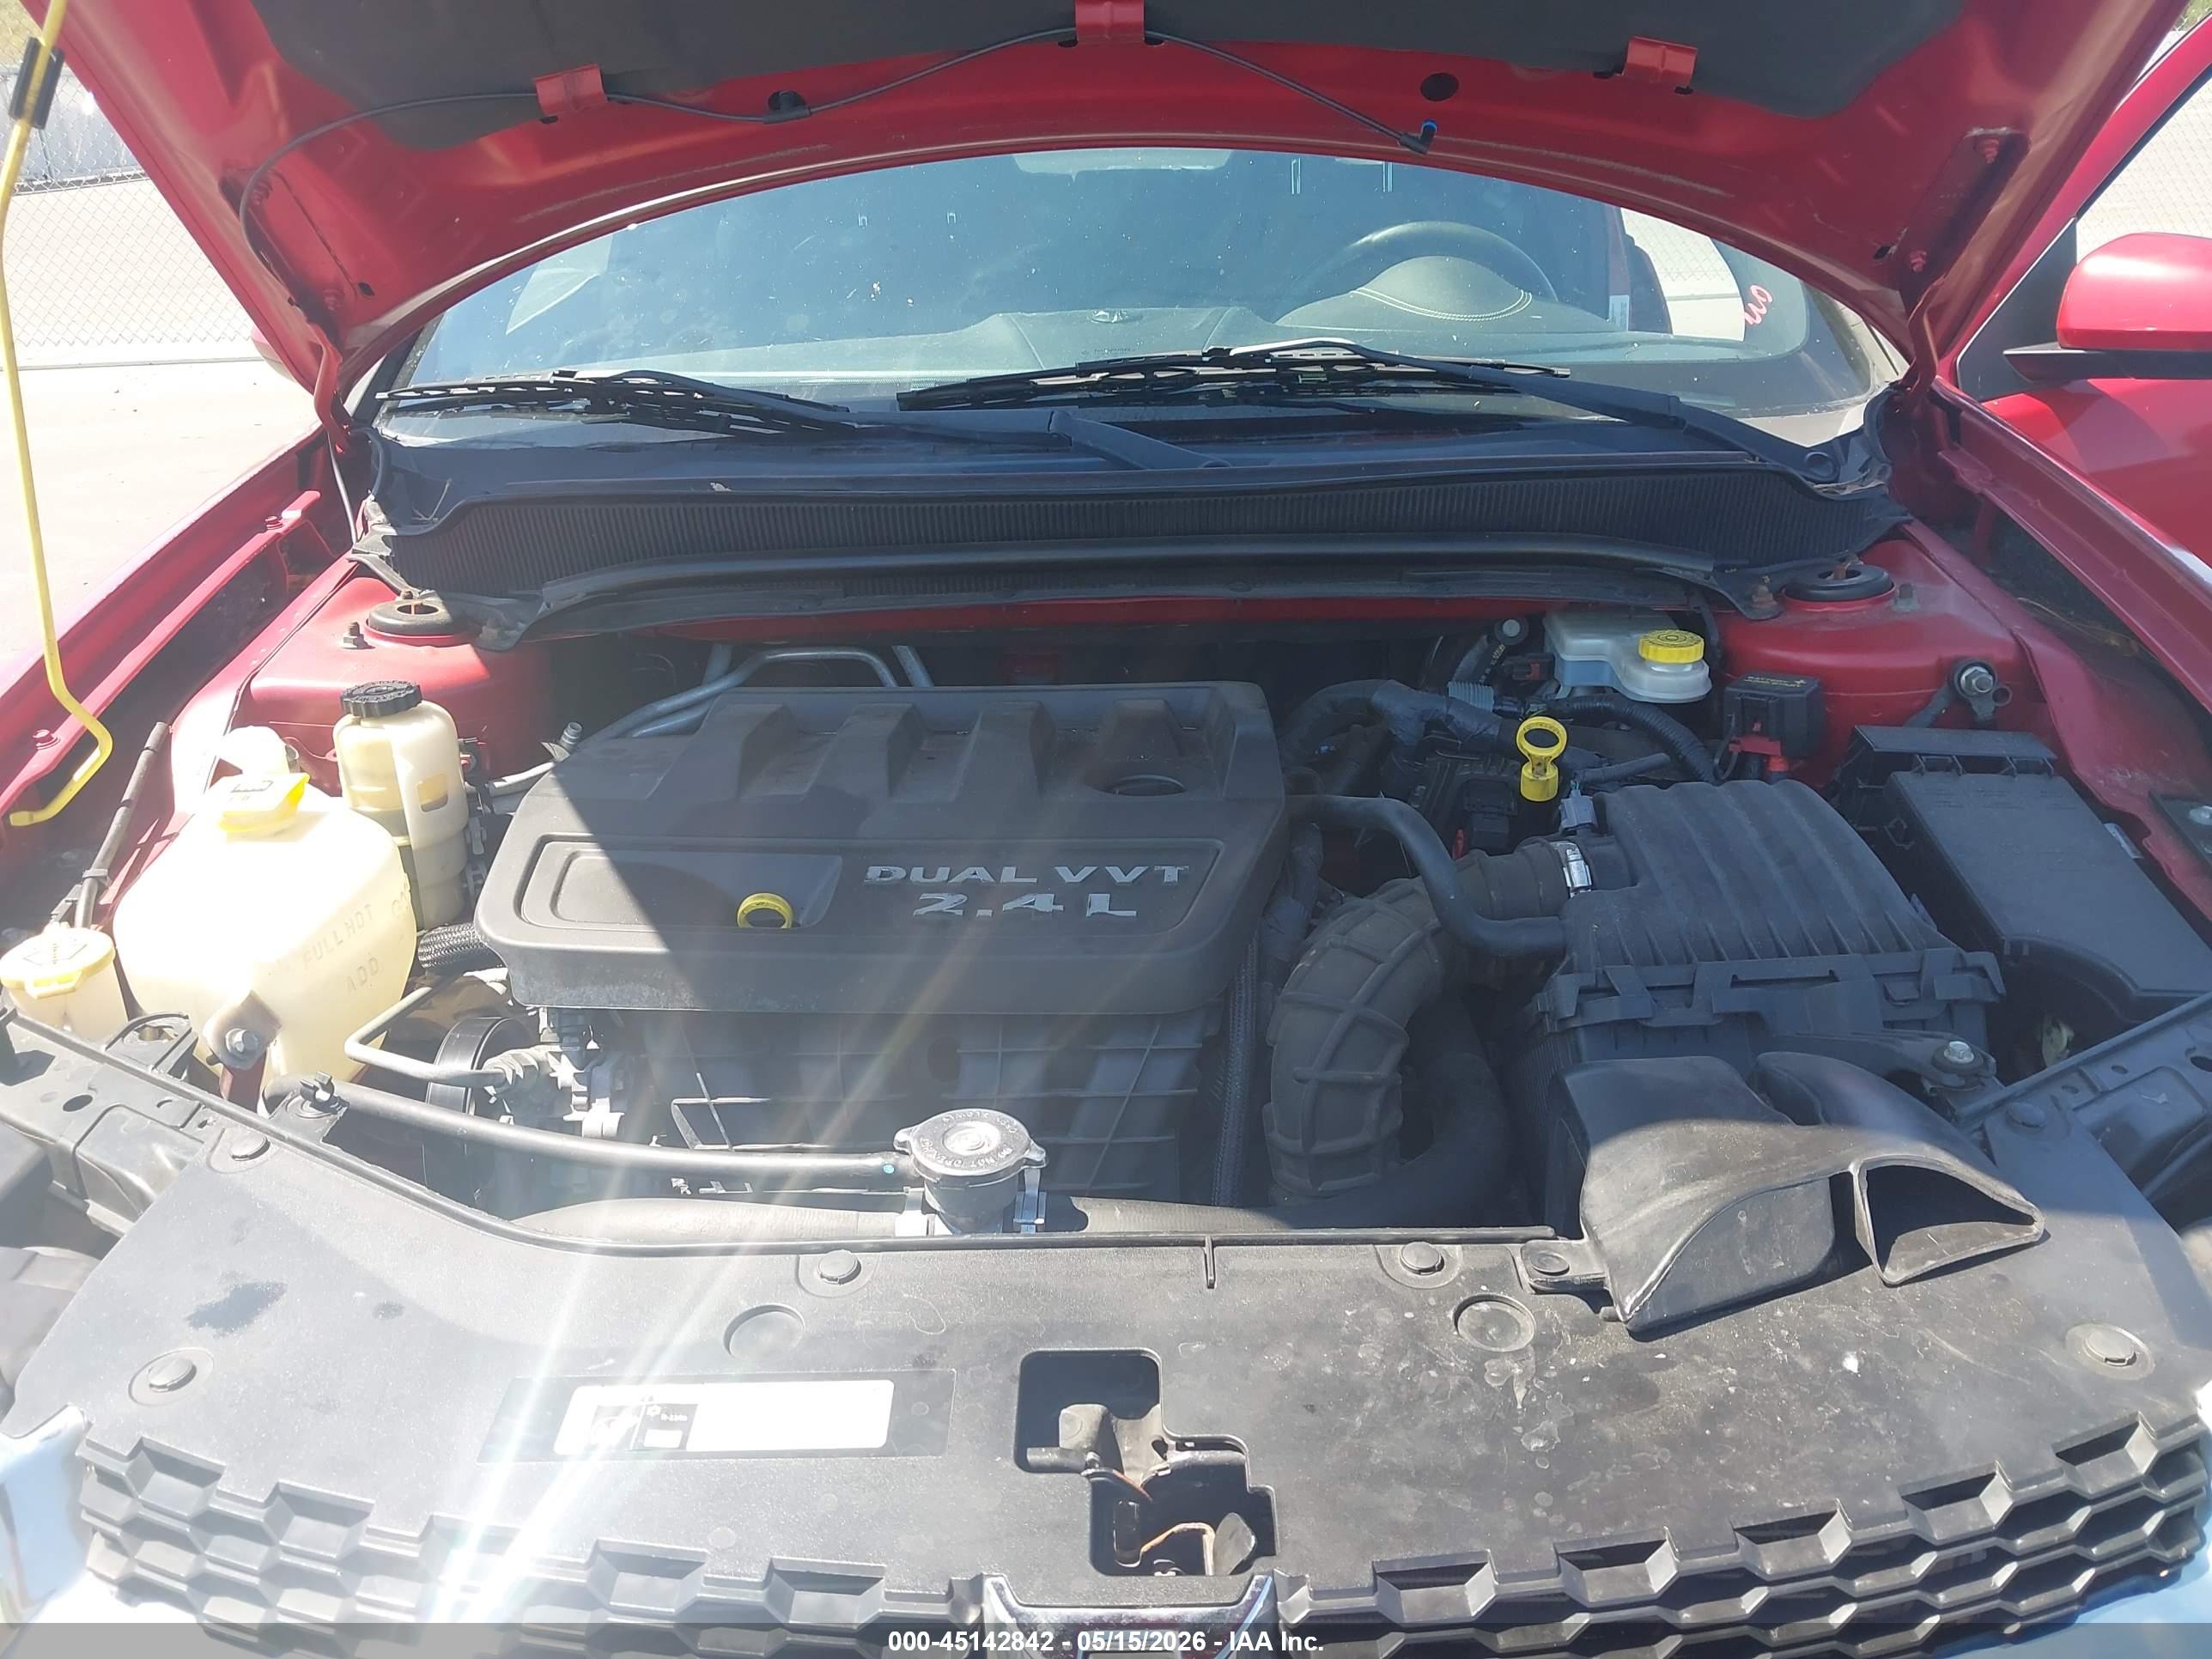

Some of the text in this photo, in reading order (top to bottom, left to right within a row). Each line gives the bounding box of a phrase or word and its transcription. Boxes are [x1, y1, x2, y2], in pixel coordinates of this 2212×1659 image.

[864, 866, 1190, 884] DUAL VVT
[345, 957, 380, 993] ADD
